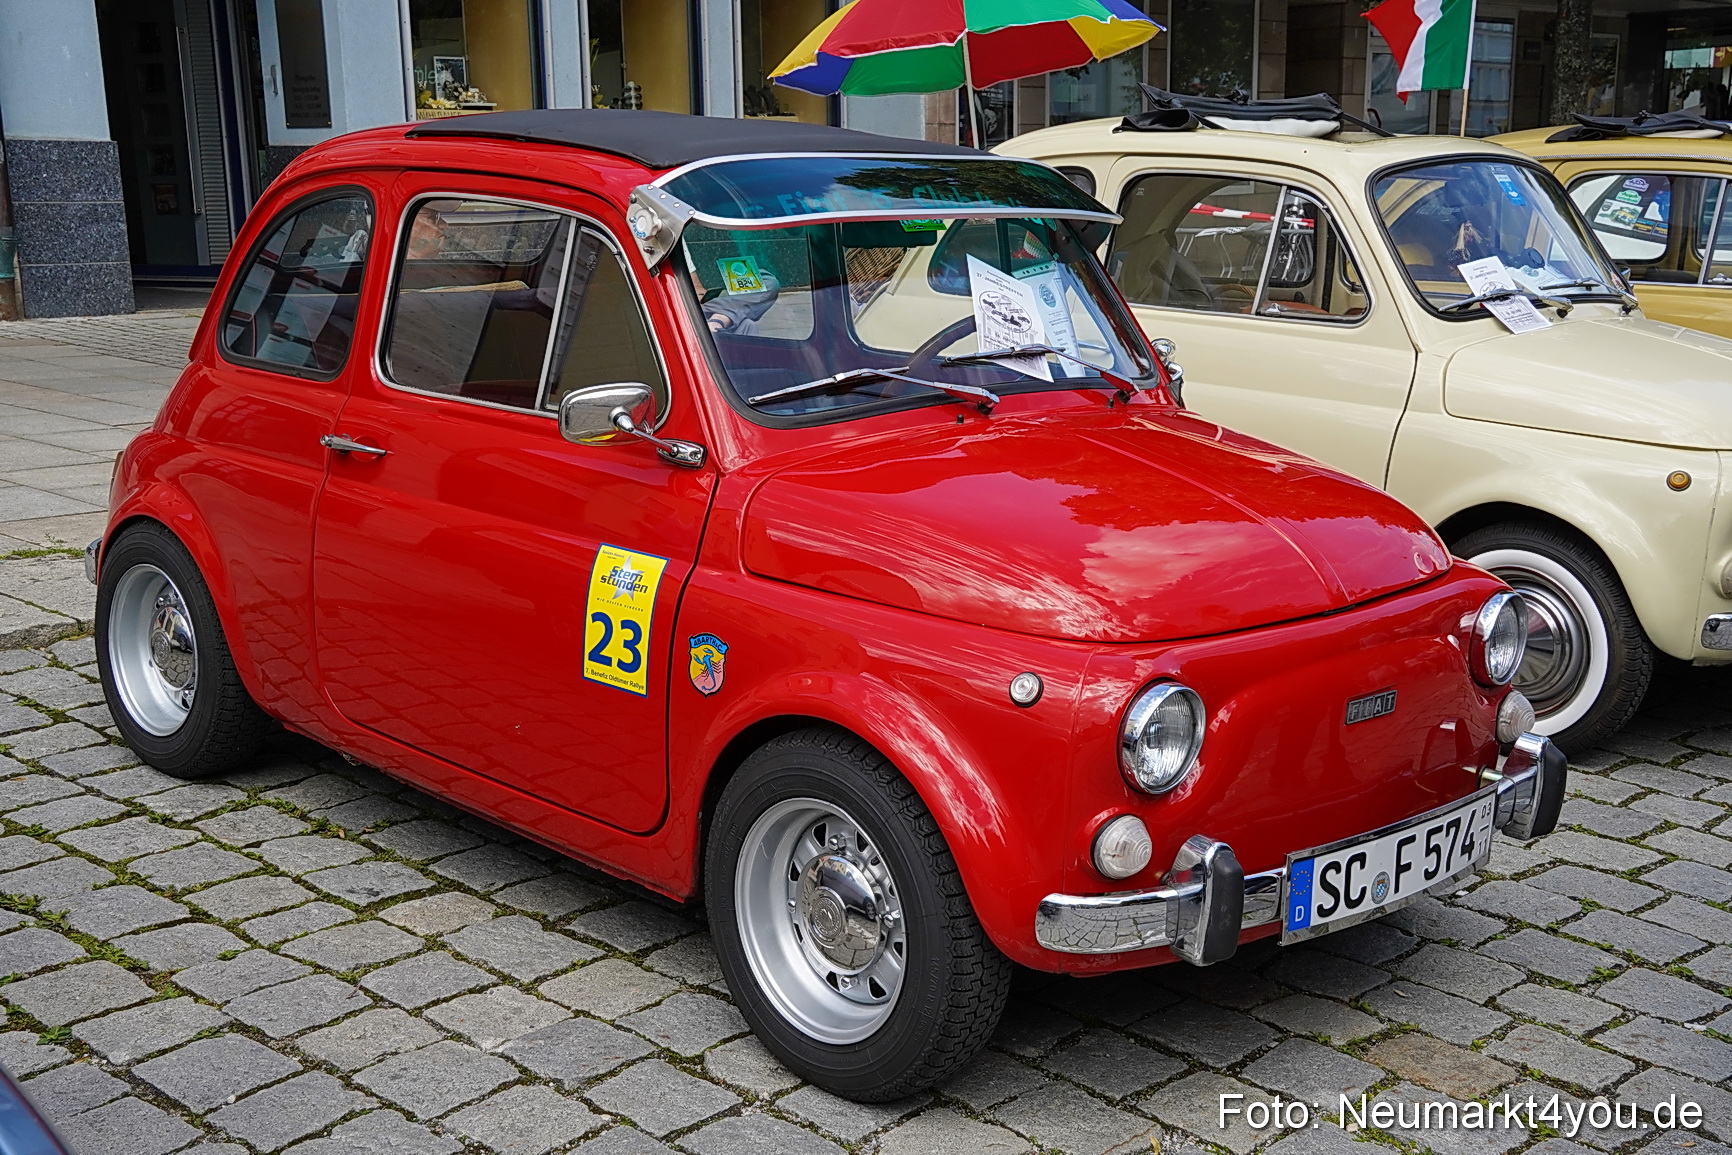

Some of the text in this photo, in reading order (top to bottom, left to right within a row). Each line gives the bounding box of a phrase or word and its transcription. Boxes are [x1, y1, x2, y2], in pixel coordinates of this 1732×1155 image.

[599, 574, 649, 594] stunden
[609, 565, 644, 583] Stern
[588, 611, 643, 674] 23
[590, 668, 609, 680] Benefiz
[608, 674, 629, 686] Oldtimer
[629, 680, 645, 691] Rallye
[1350, 693, 1395, 721] FIAT
[1480, 801, 1492, 819] 03
[1316, 851, 1367, 918] SC
[1423, 808, 1478, 881] 574
[1294, 905, 1305, 923] D
